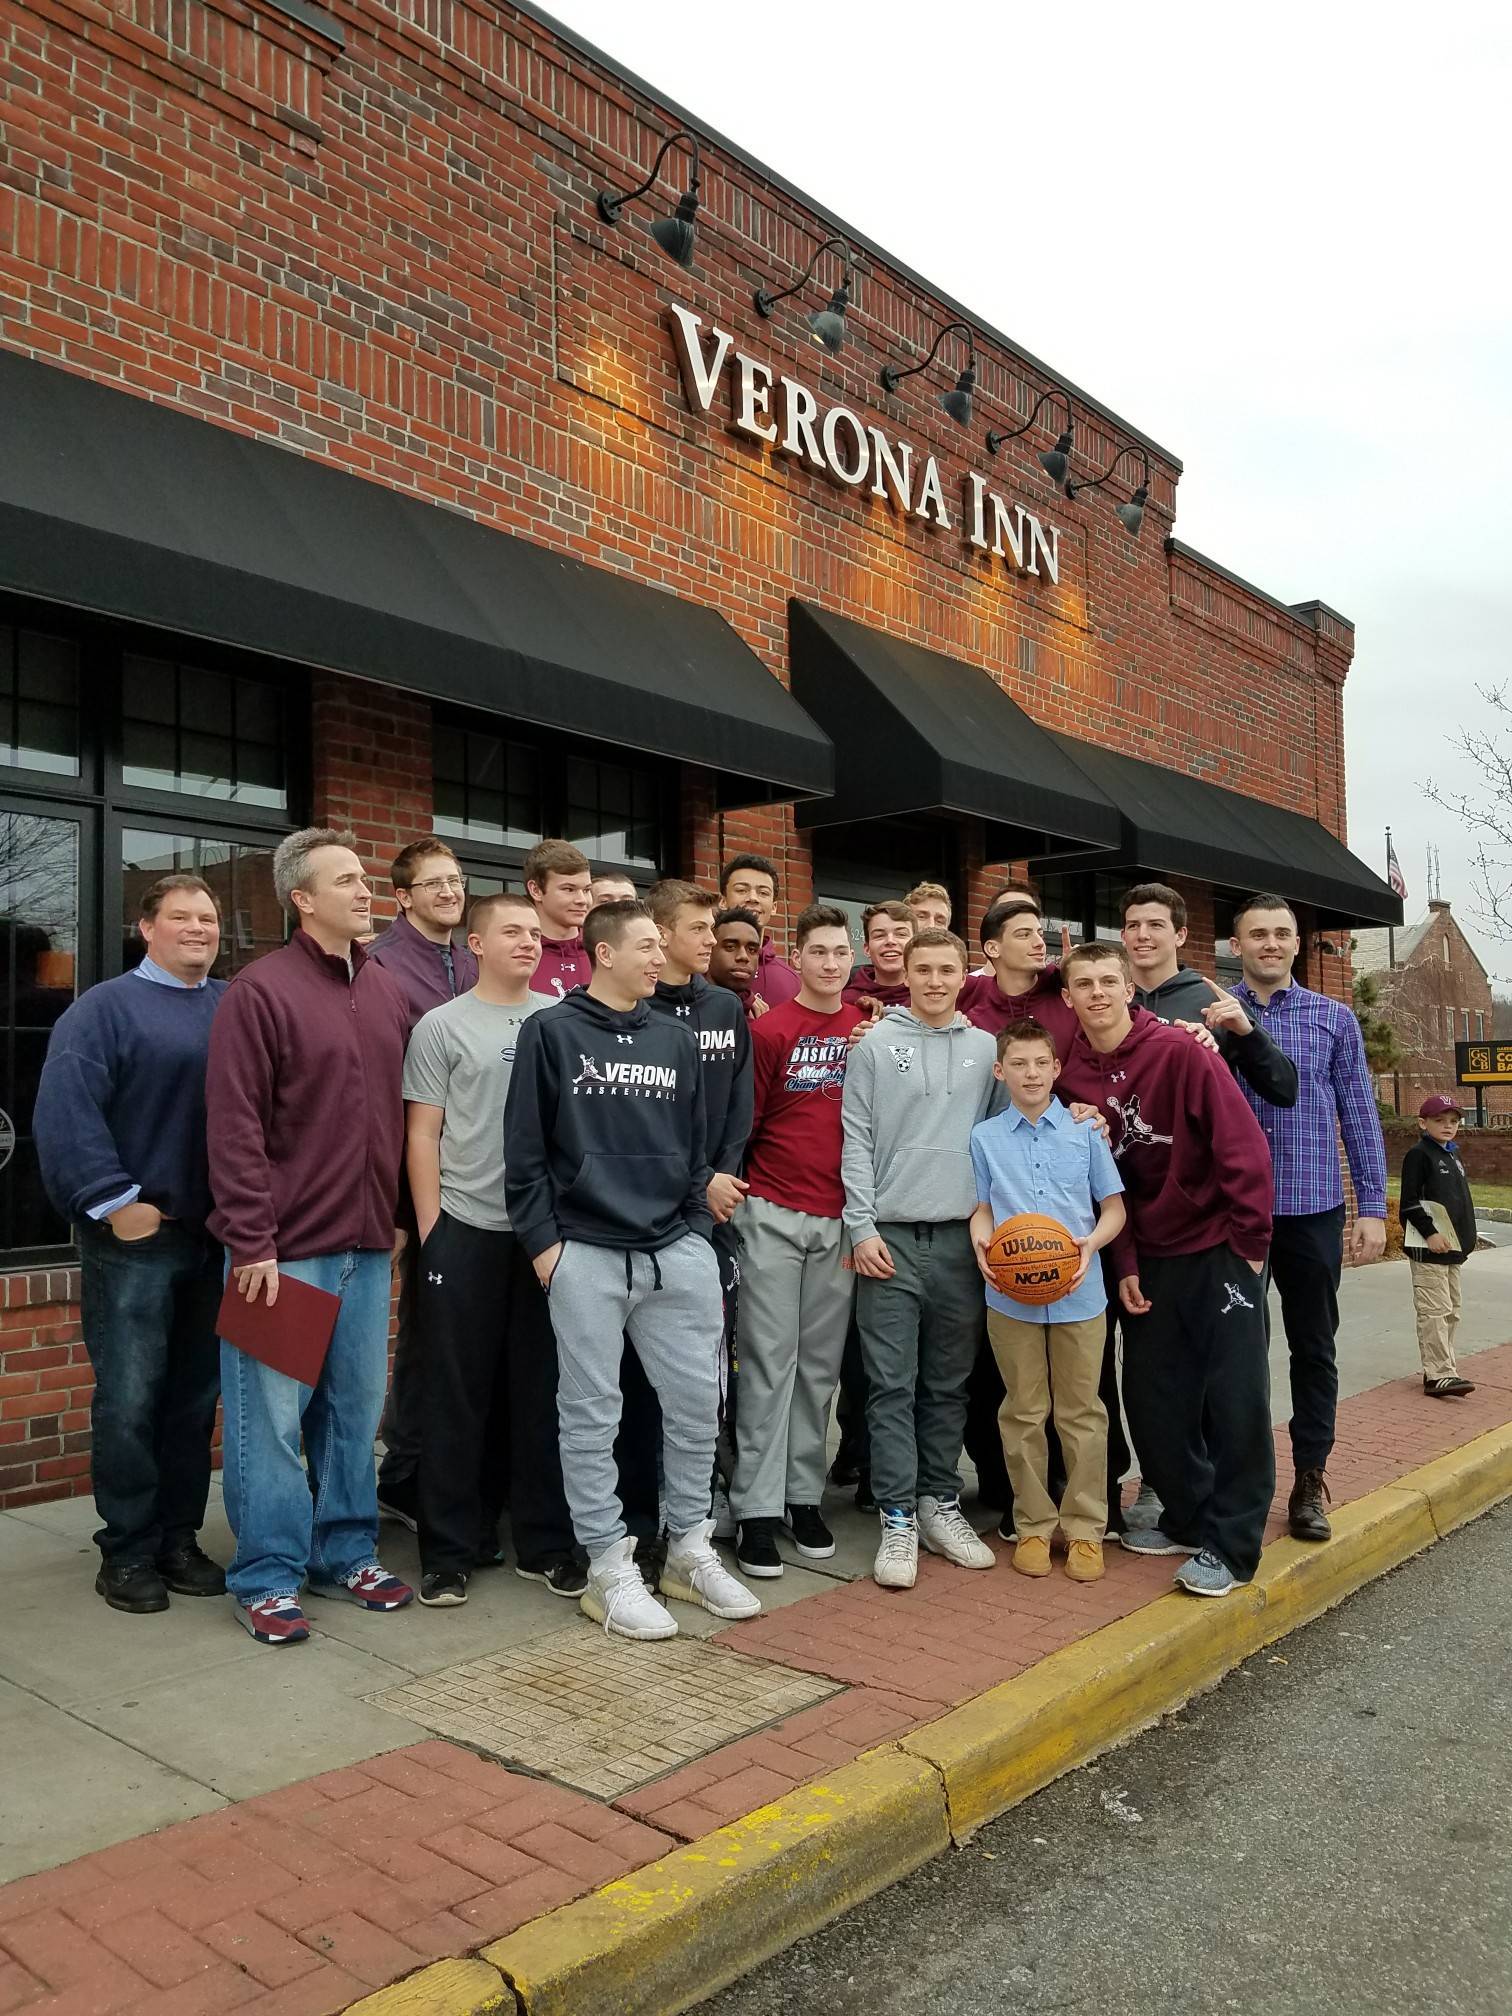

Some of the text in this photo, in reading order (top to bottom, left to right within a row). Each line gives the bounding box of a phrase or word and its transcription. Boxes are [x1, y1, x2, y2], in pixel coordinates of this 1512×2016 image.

[671, 303, 1060, 585] VERONA INN
[694, 1029, 736, 1050] ONA
[605, 1062, 677, 1089] VERONA
[573, 1086, 676, 1102] BASKETBALL
[1001, 1236, 1065, 1257] Wilson
[1014, 1267, 1060, 1285] NCAA
